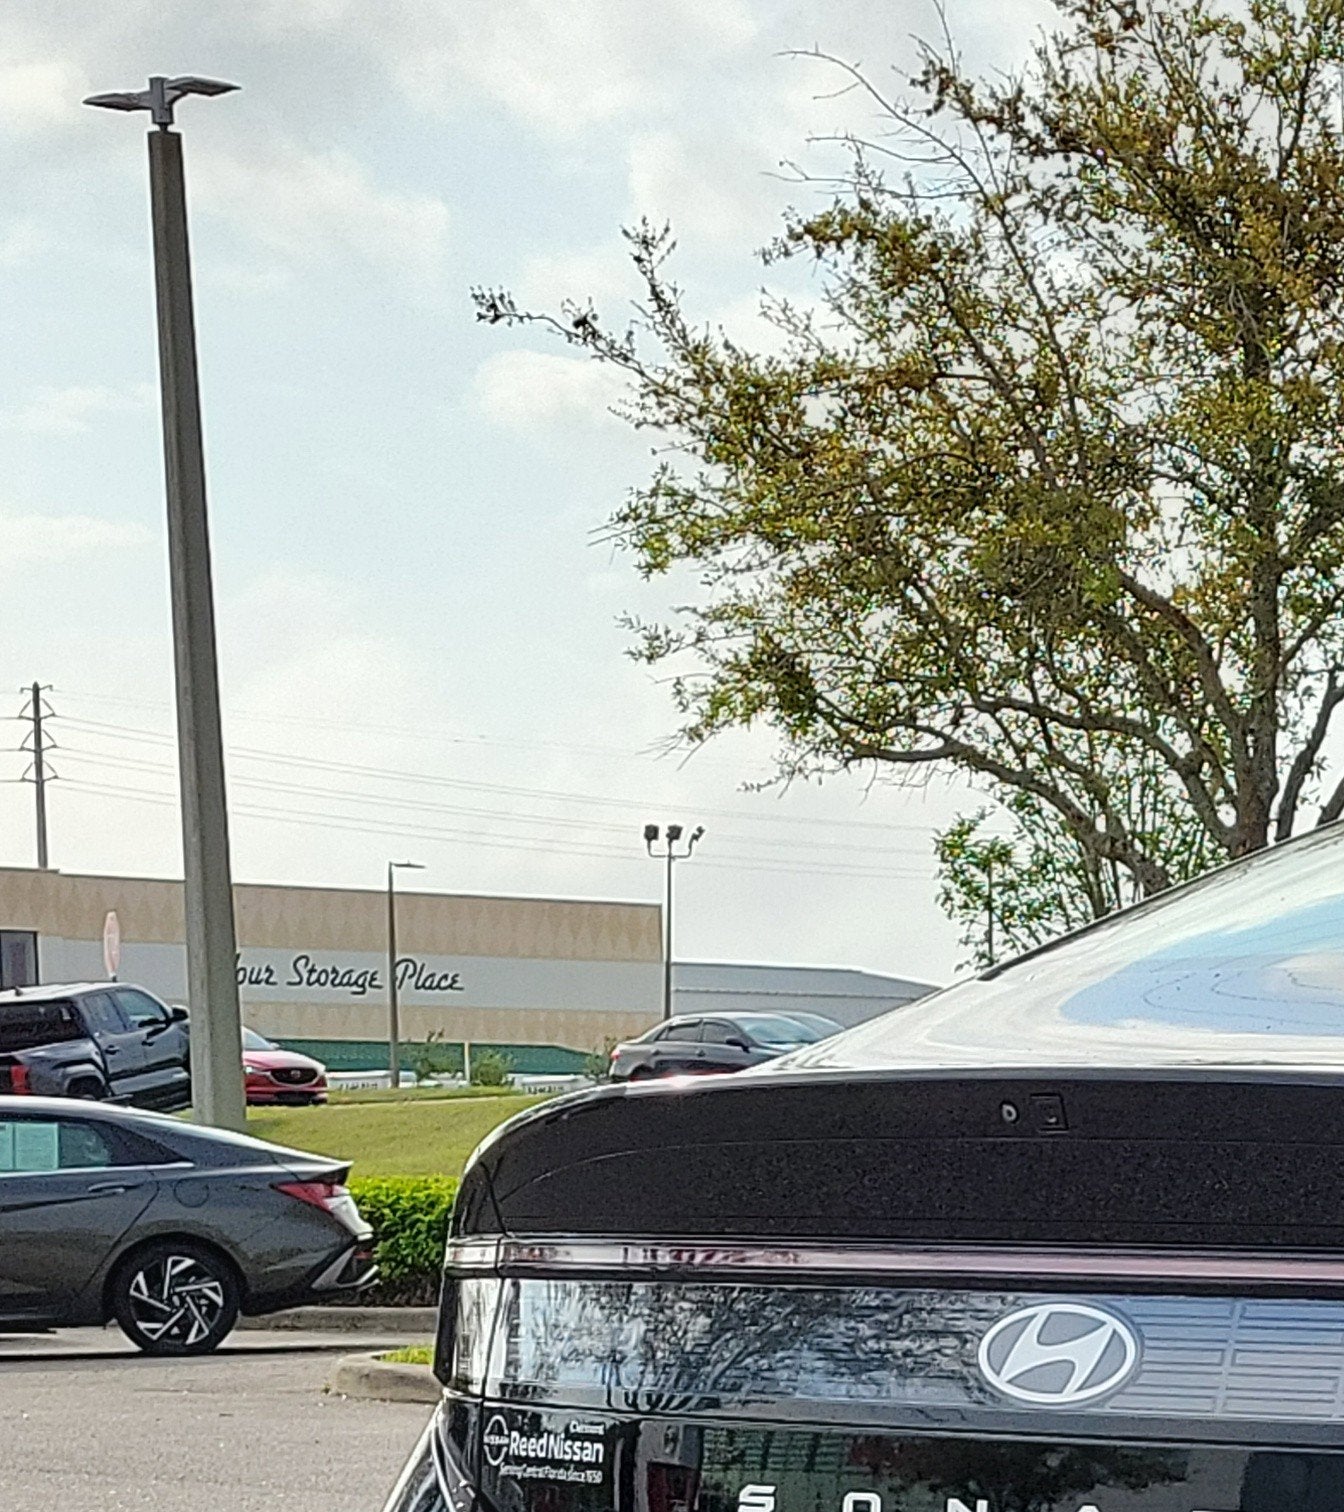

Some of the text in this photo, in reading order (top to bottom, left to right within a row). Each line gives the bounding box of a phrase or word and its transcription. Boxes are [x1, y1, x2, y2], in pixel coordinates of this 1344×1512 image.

[235, 952, 465, 995] our Storage Place
[508, 1430, 605, 1463] ReedNissan
